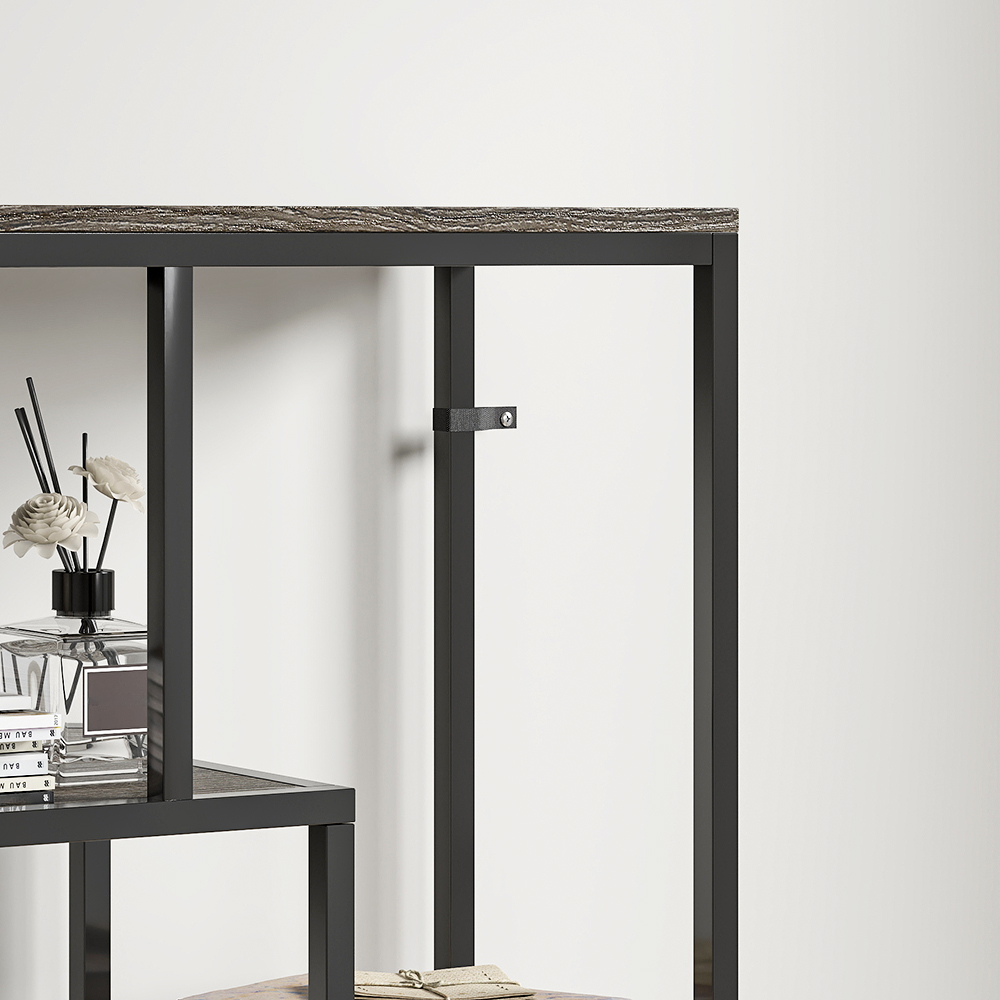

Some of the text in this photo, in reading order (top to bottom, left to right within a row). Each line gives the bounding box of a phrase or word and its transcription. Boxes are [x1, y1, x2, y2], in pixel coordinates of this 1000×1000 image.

[15, 730, 33, 738] BAU
[0, 742, 16, 750] BAU
[3, 762, 20, 770] BAU
[9, 781, 27, 789] BAU
